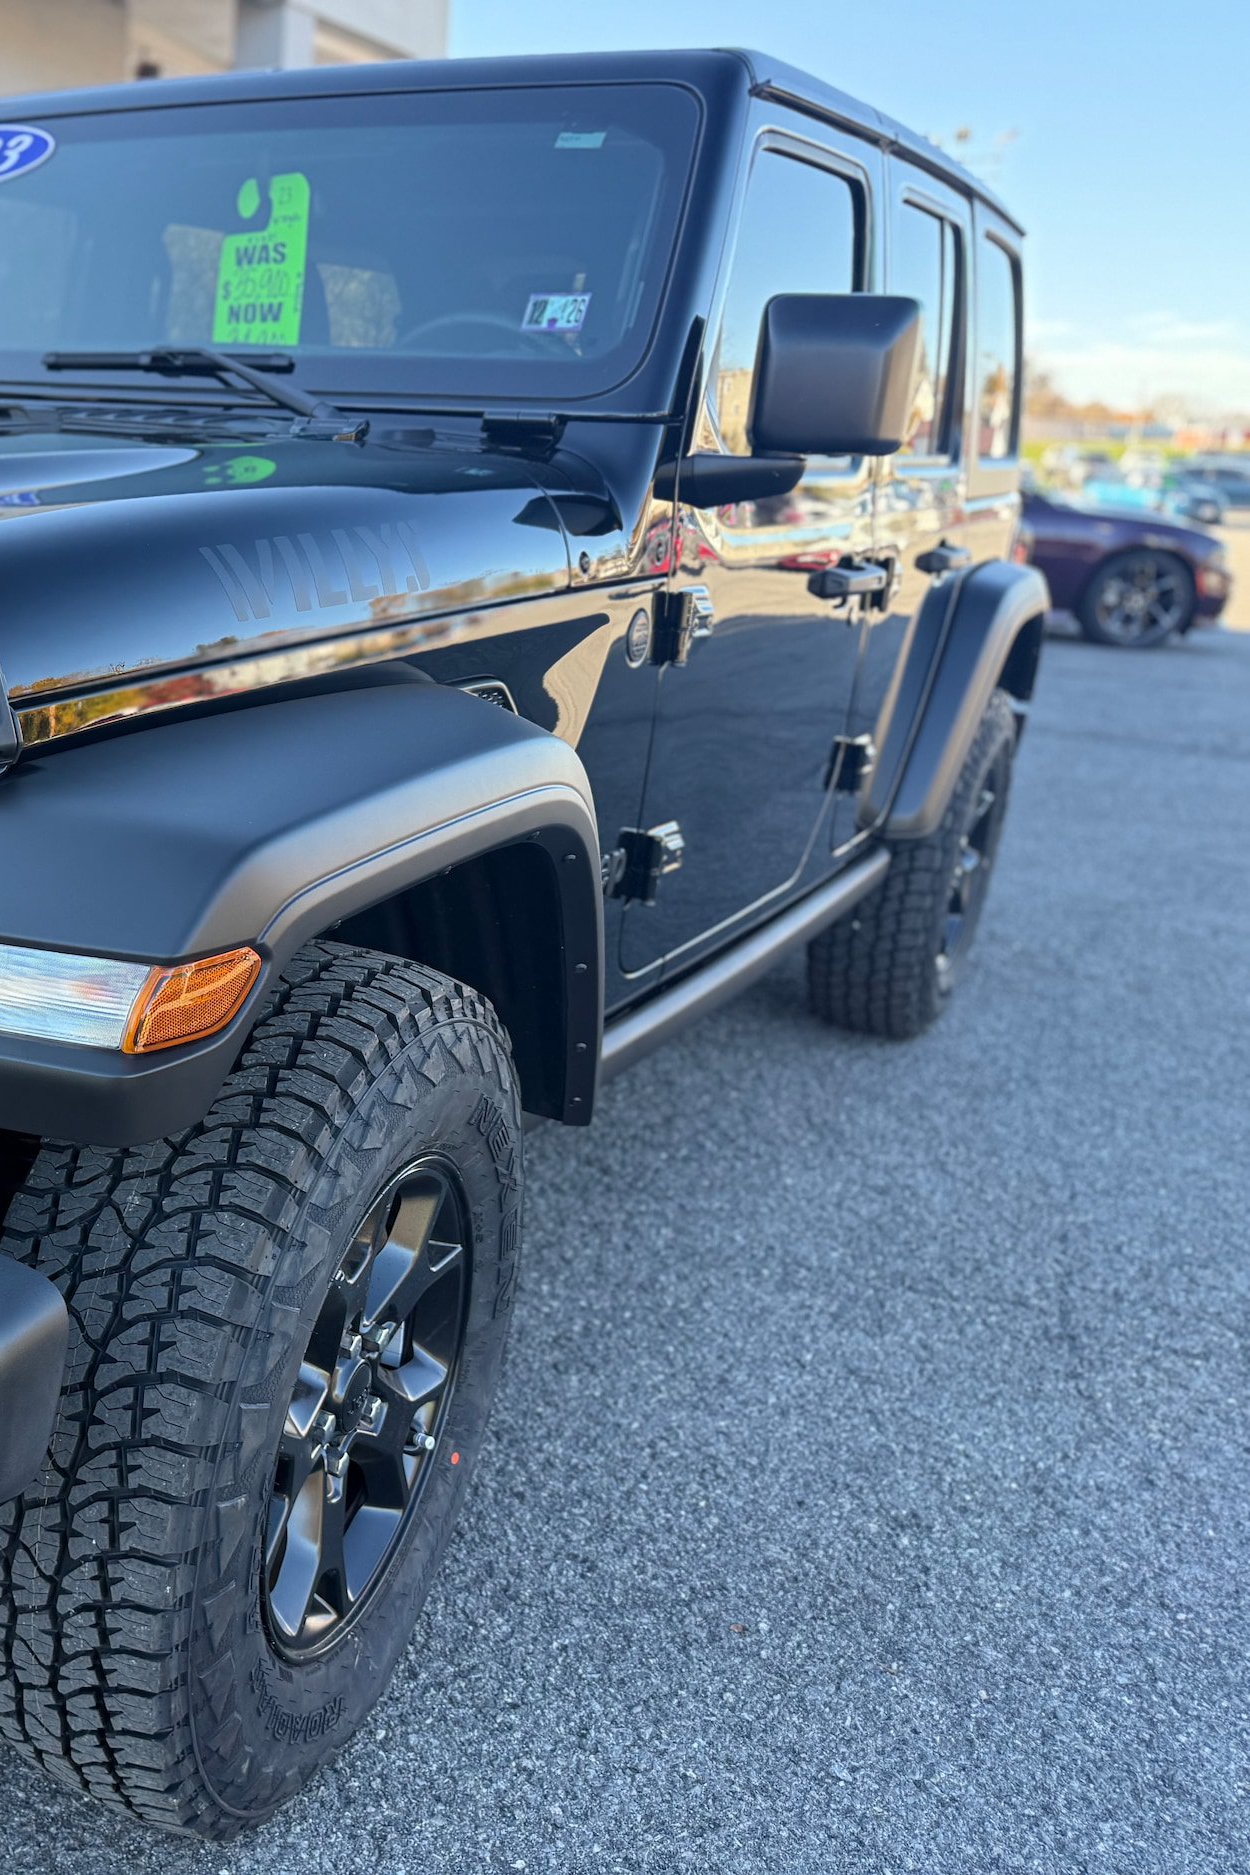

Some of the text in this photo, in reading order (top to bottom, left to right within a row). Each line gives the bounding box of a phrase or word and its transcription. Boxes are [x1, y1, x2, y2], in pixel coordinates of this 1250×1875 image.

[235, 242, 287, 267] WAS
[228, 302, 283, 325] NOW
[199, 520, 432, 622] WILLYS
[468, 1093, 519, 1320] NEXEN
